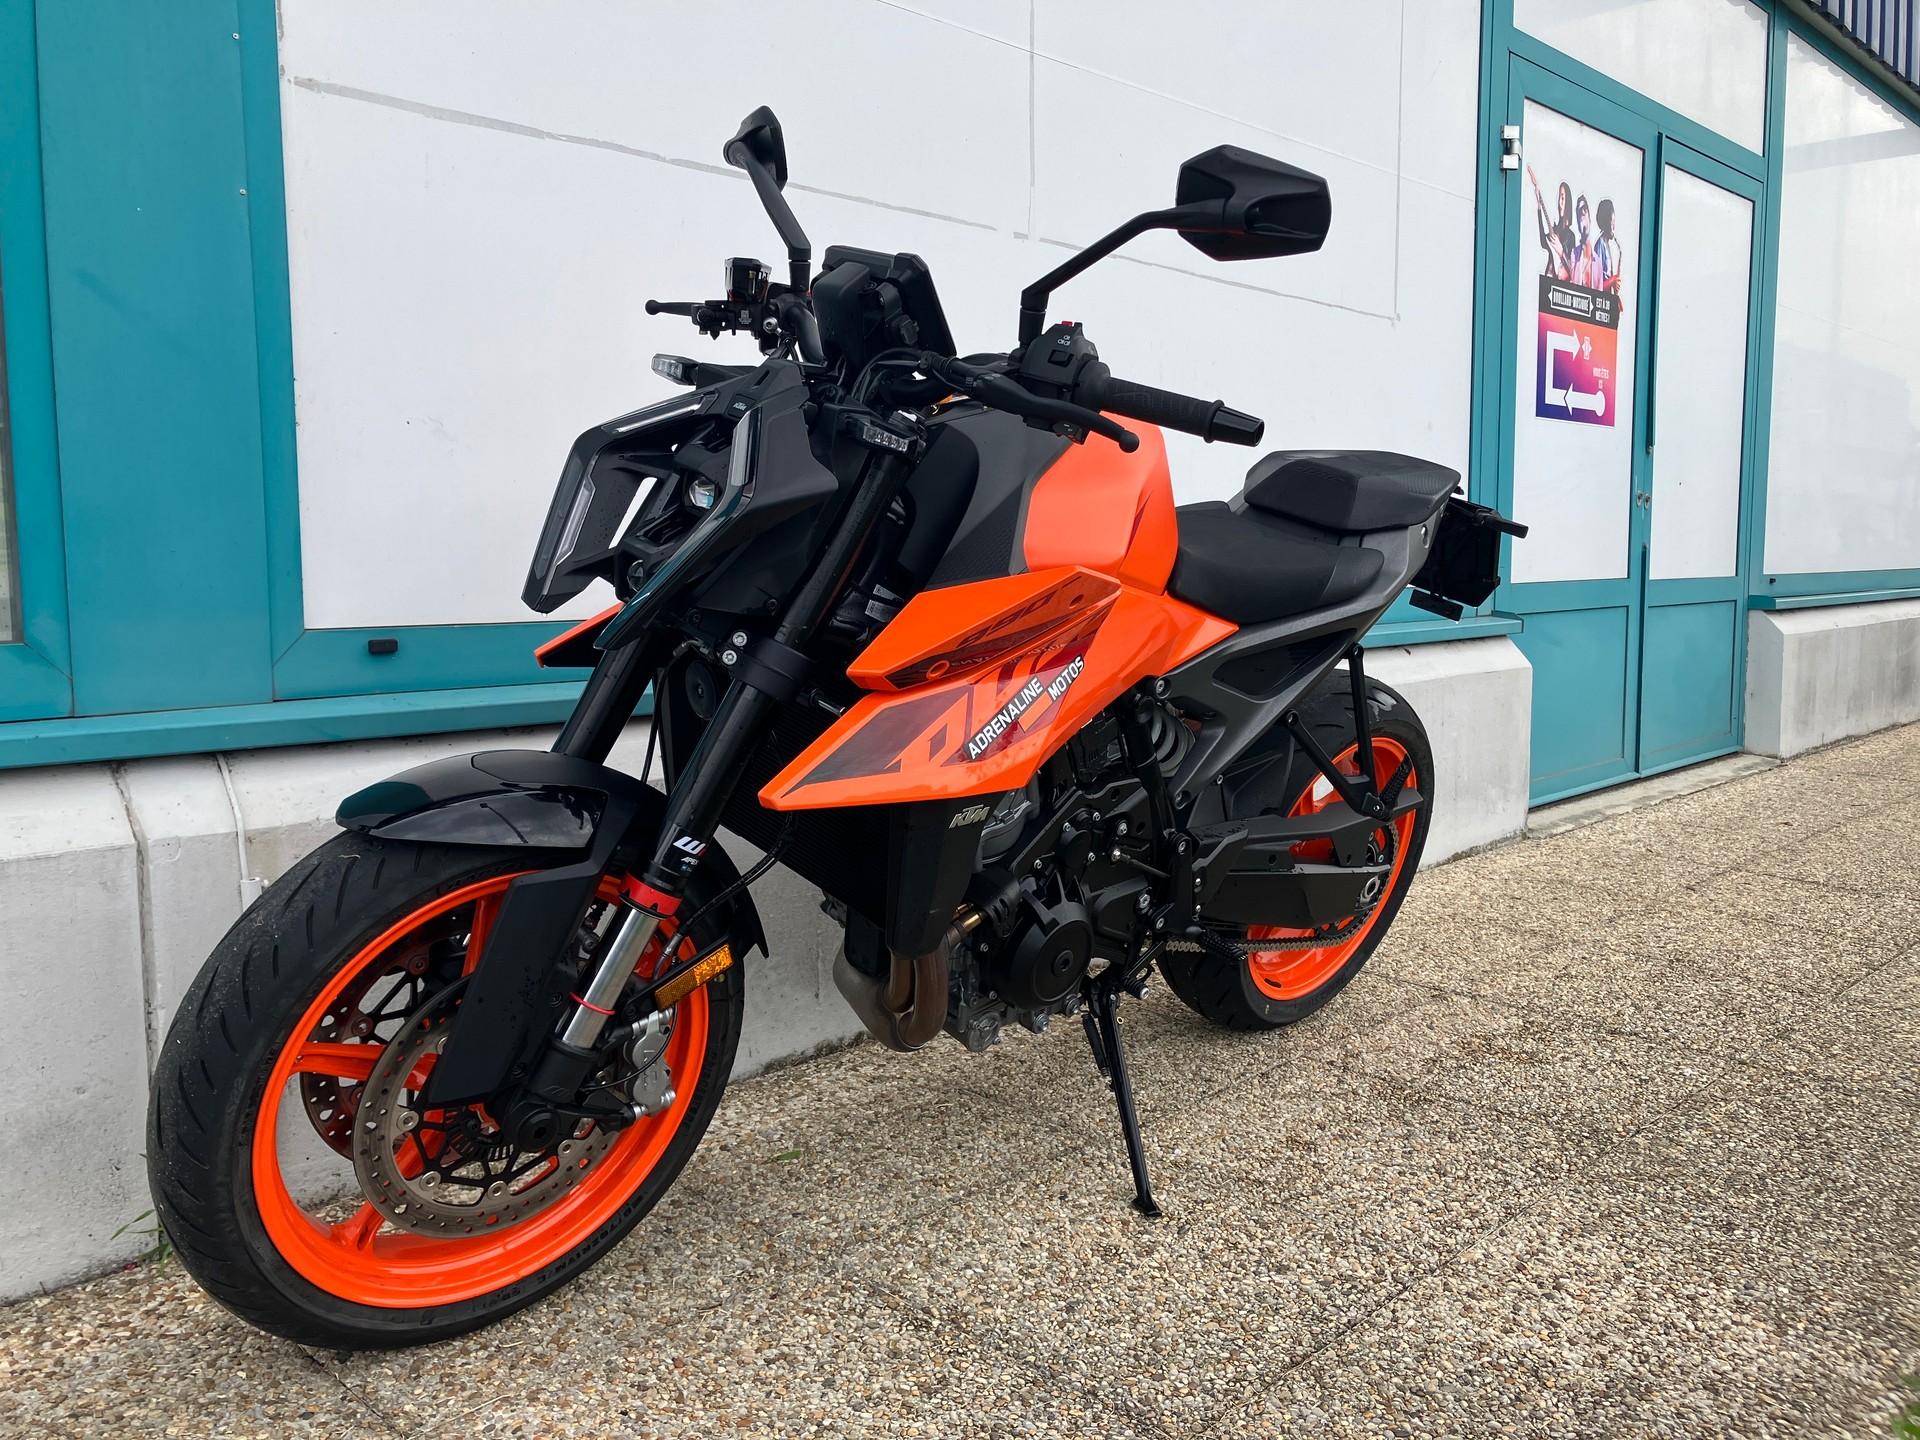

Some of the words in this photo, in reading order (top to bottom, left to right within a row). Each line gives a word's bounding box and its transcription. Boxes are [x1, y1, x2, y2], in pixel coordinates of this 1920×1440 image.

[1047, 655, 1084, 701] MOTOS
[968, 676, 1044, 760] ADRENALINE
[948, 804, 991, 829] KTM
